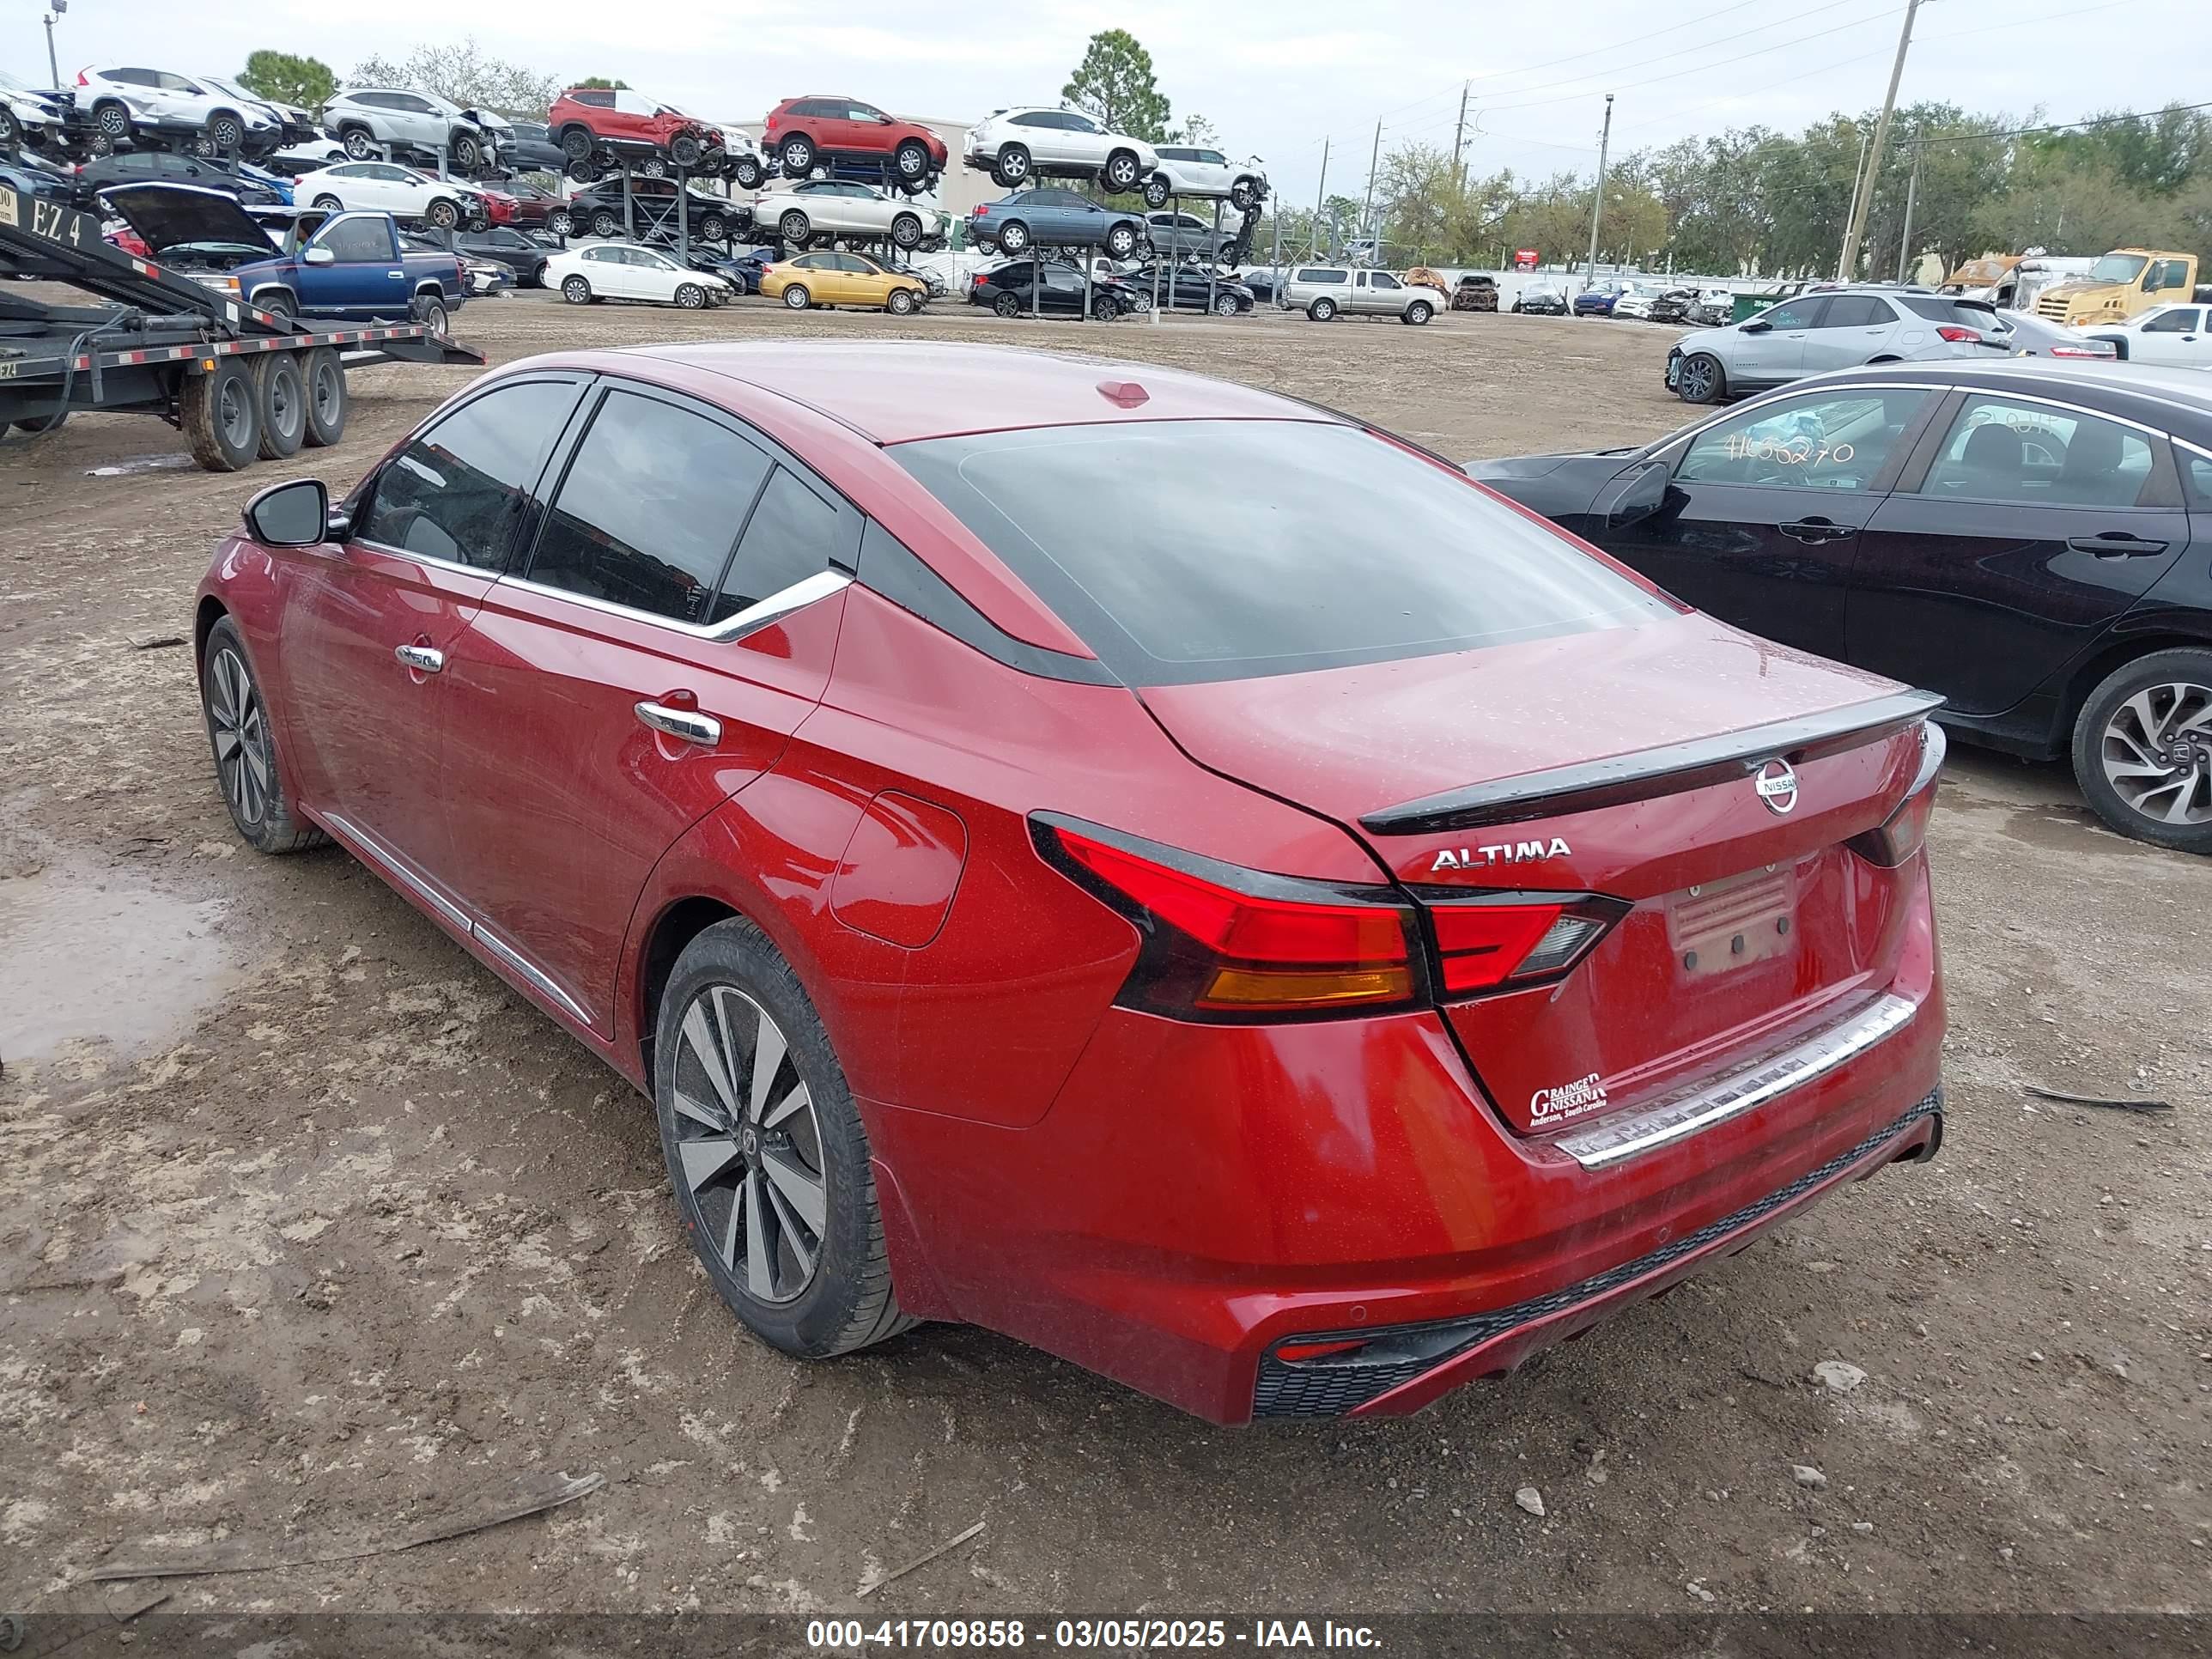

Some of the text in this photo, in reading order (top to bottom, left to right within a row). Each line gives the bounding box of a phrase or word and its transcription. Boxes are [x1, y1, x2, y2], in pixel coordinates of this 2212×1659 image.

[32, 199, 81, 247] EZ 4
[1764, 777, 1798, 793] NISSAN
[1431, 836, 1572, 872] ALTIMA
[1529, 1099, 1607, 1127] Anderson, South Carolina
[1549, 1090, 1593, 1113] NISSAN
